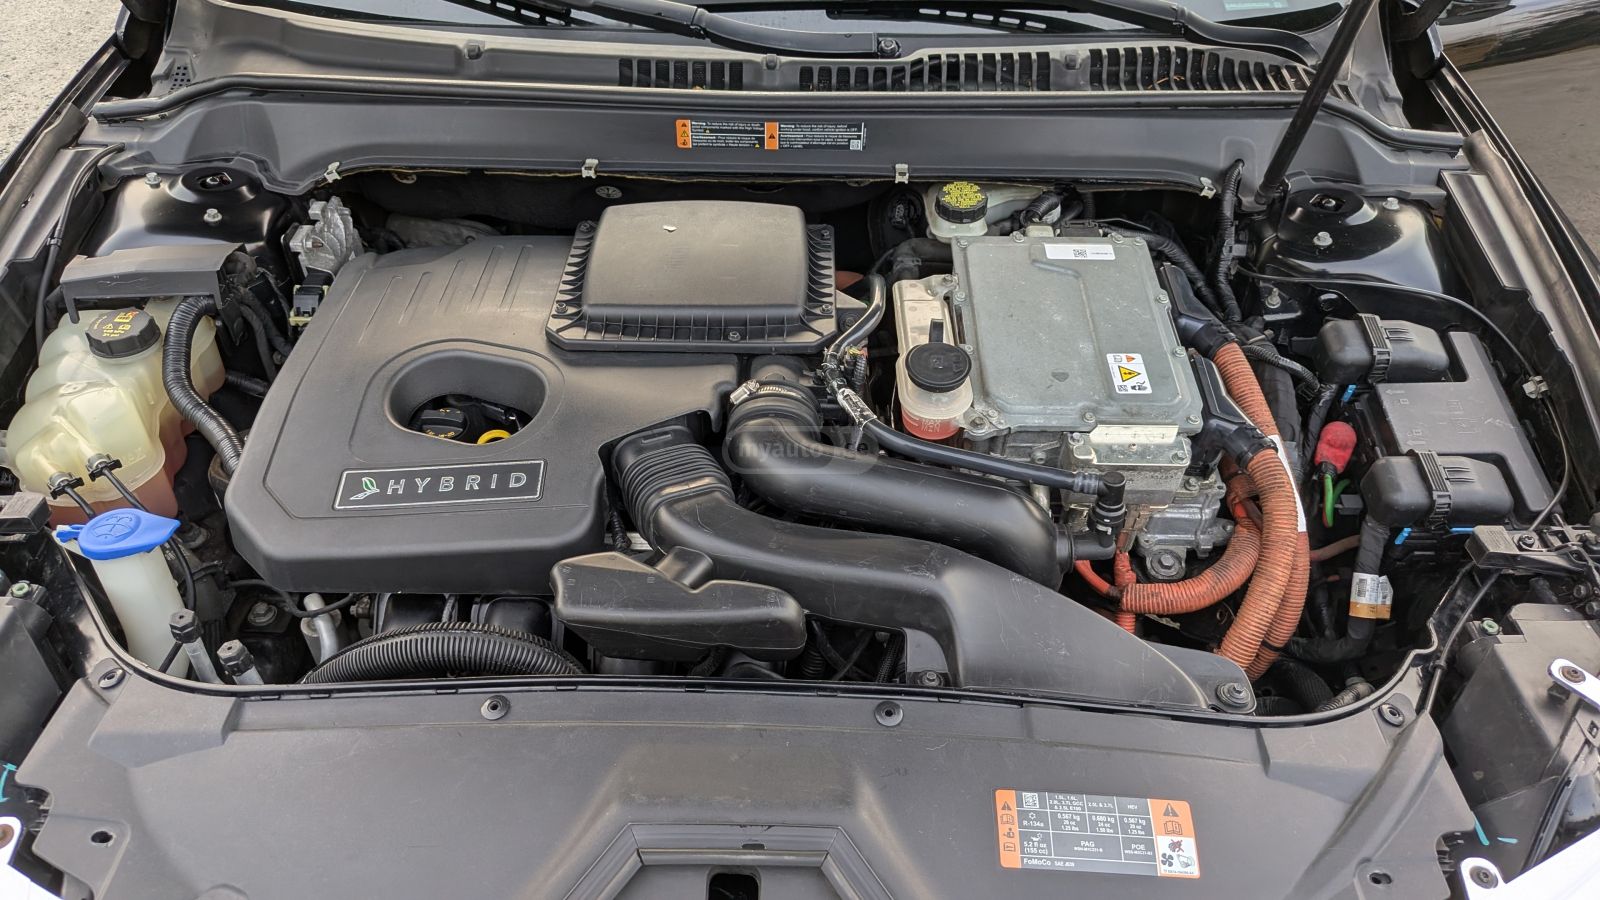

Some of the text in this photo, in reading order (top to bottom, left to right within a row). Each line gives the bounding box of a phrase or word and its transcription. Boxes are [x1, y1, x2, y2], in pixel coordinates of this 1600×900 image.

[386, 472, 528, 496] HYBRID
[1022, 820, 1044, 828] R-134a
[1024, 858, 1051, 866] FoMoCo
